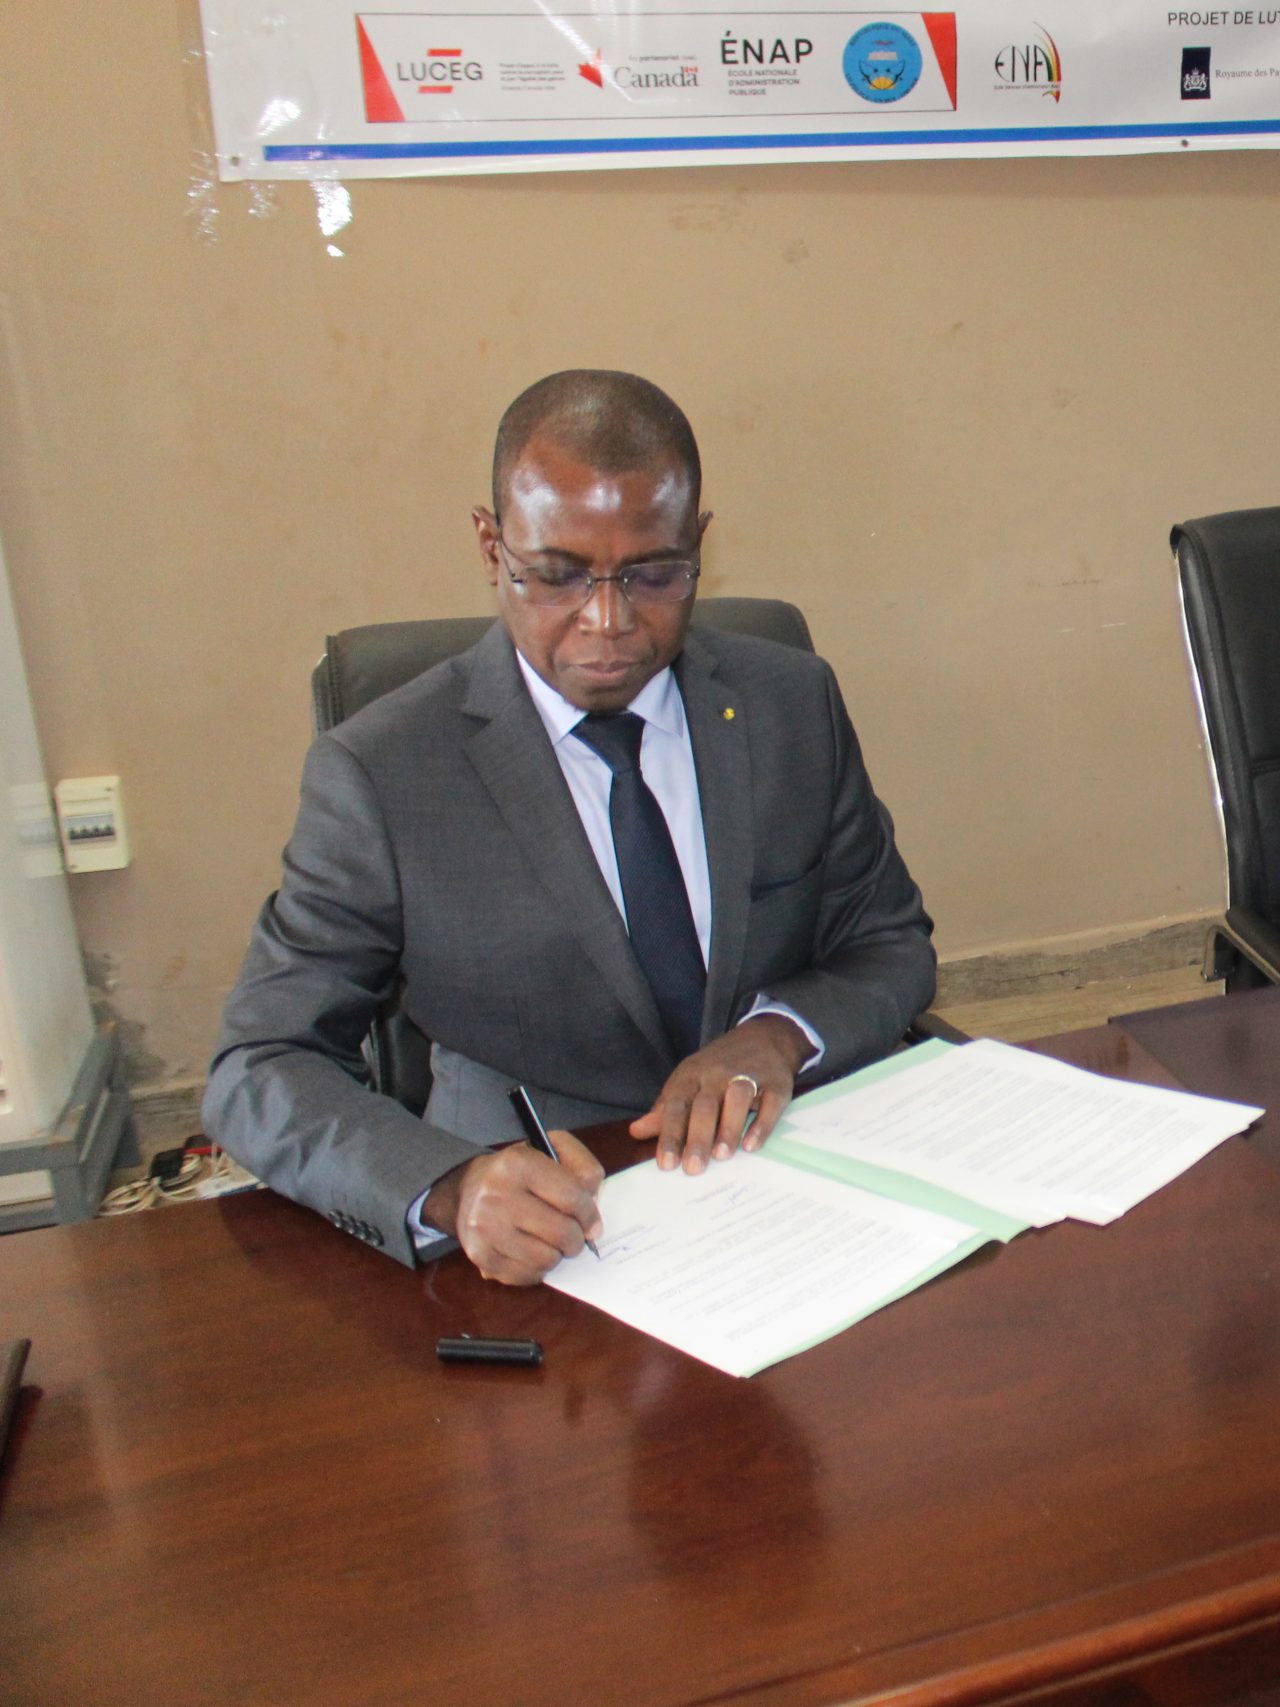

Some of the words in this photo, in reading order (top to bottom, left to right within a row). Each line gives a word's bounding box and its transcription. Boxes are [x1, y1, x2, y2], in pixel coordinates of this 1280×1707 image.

[1167, 11, 1229, 26] PROJET
[1233, 11, 1254, 25] DE
[721, 30, 814, 65] ÉNAP
[396, 62, 484, 81] LUCEG
[995, 44, 1054, 82] ENA
[613, 66, 699, 88] Canada
[755, 68, 797, 76] NATIONALE
[1215, 69, 1252, 80] Royaume
[1254, 68, 1268, 77] des
[729, 88, 766, 96] PUBLIQUE
